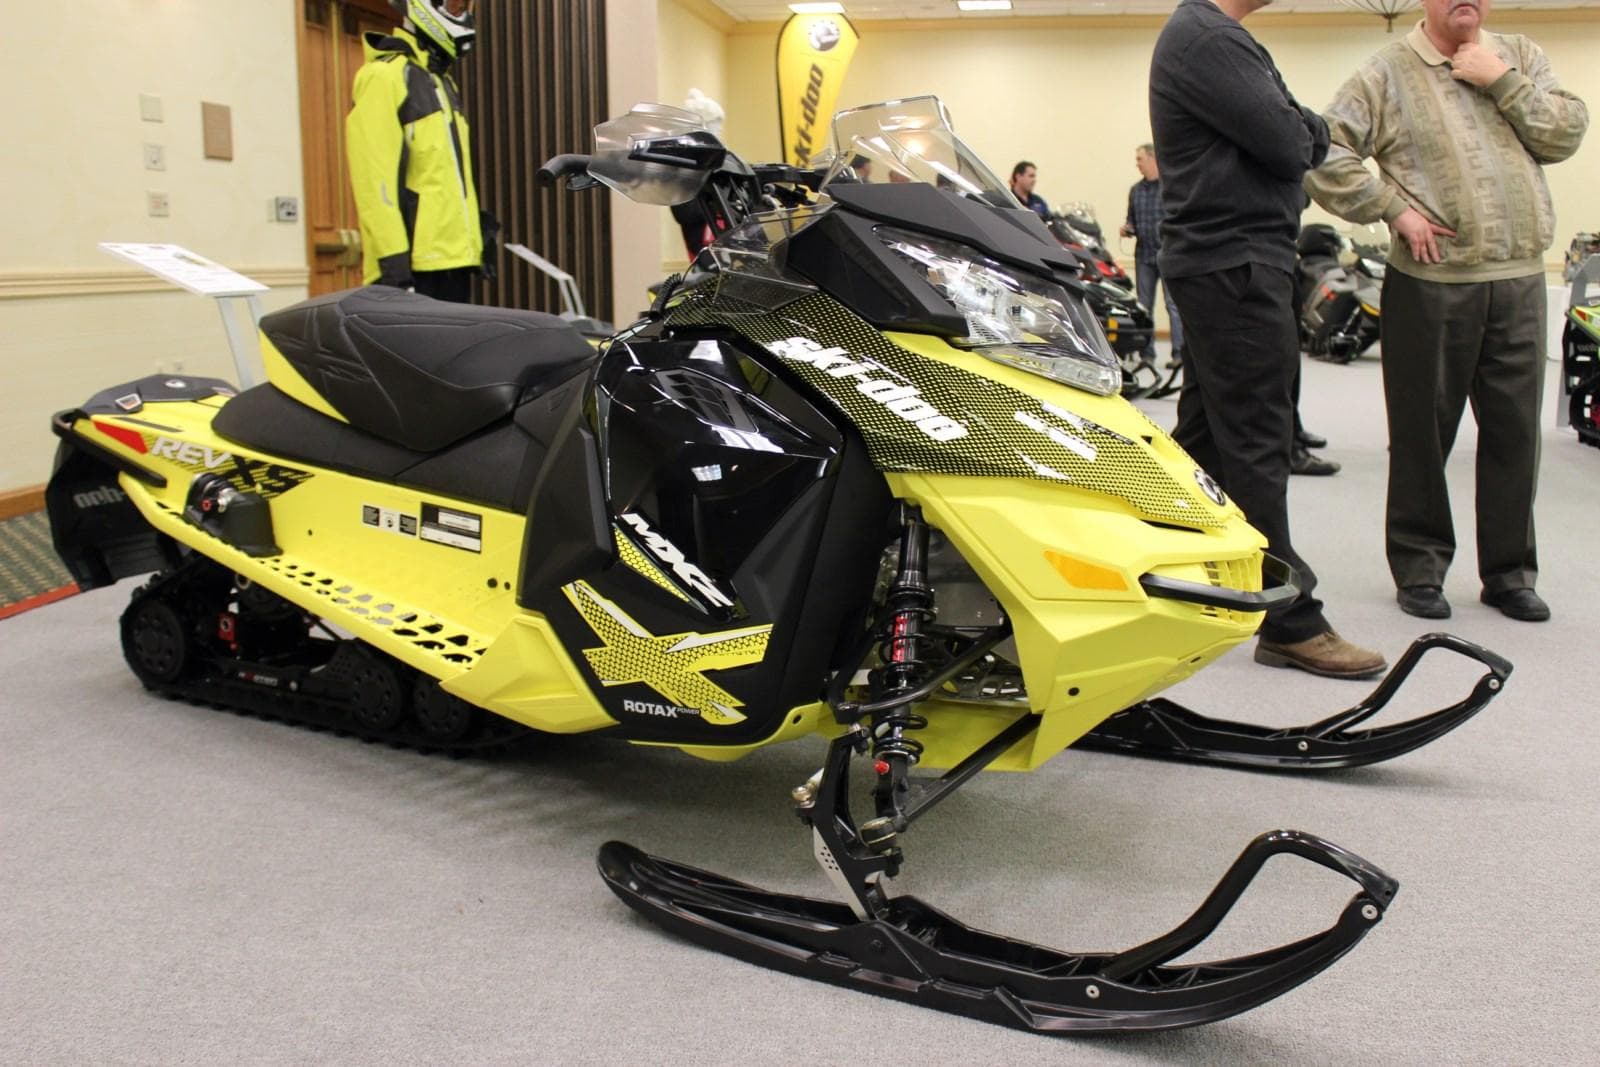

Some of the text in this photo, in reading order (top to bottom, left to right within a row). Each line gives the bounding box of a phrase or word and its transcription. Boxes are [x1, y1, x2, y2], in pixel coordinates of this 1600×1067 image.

[151, 436, 231, 469] REV
[623, 699, 700, 719] ROTAX POWER
